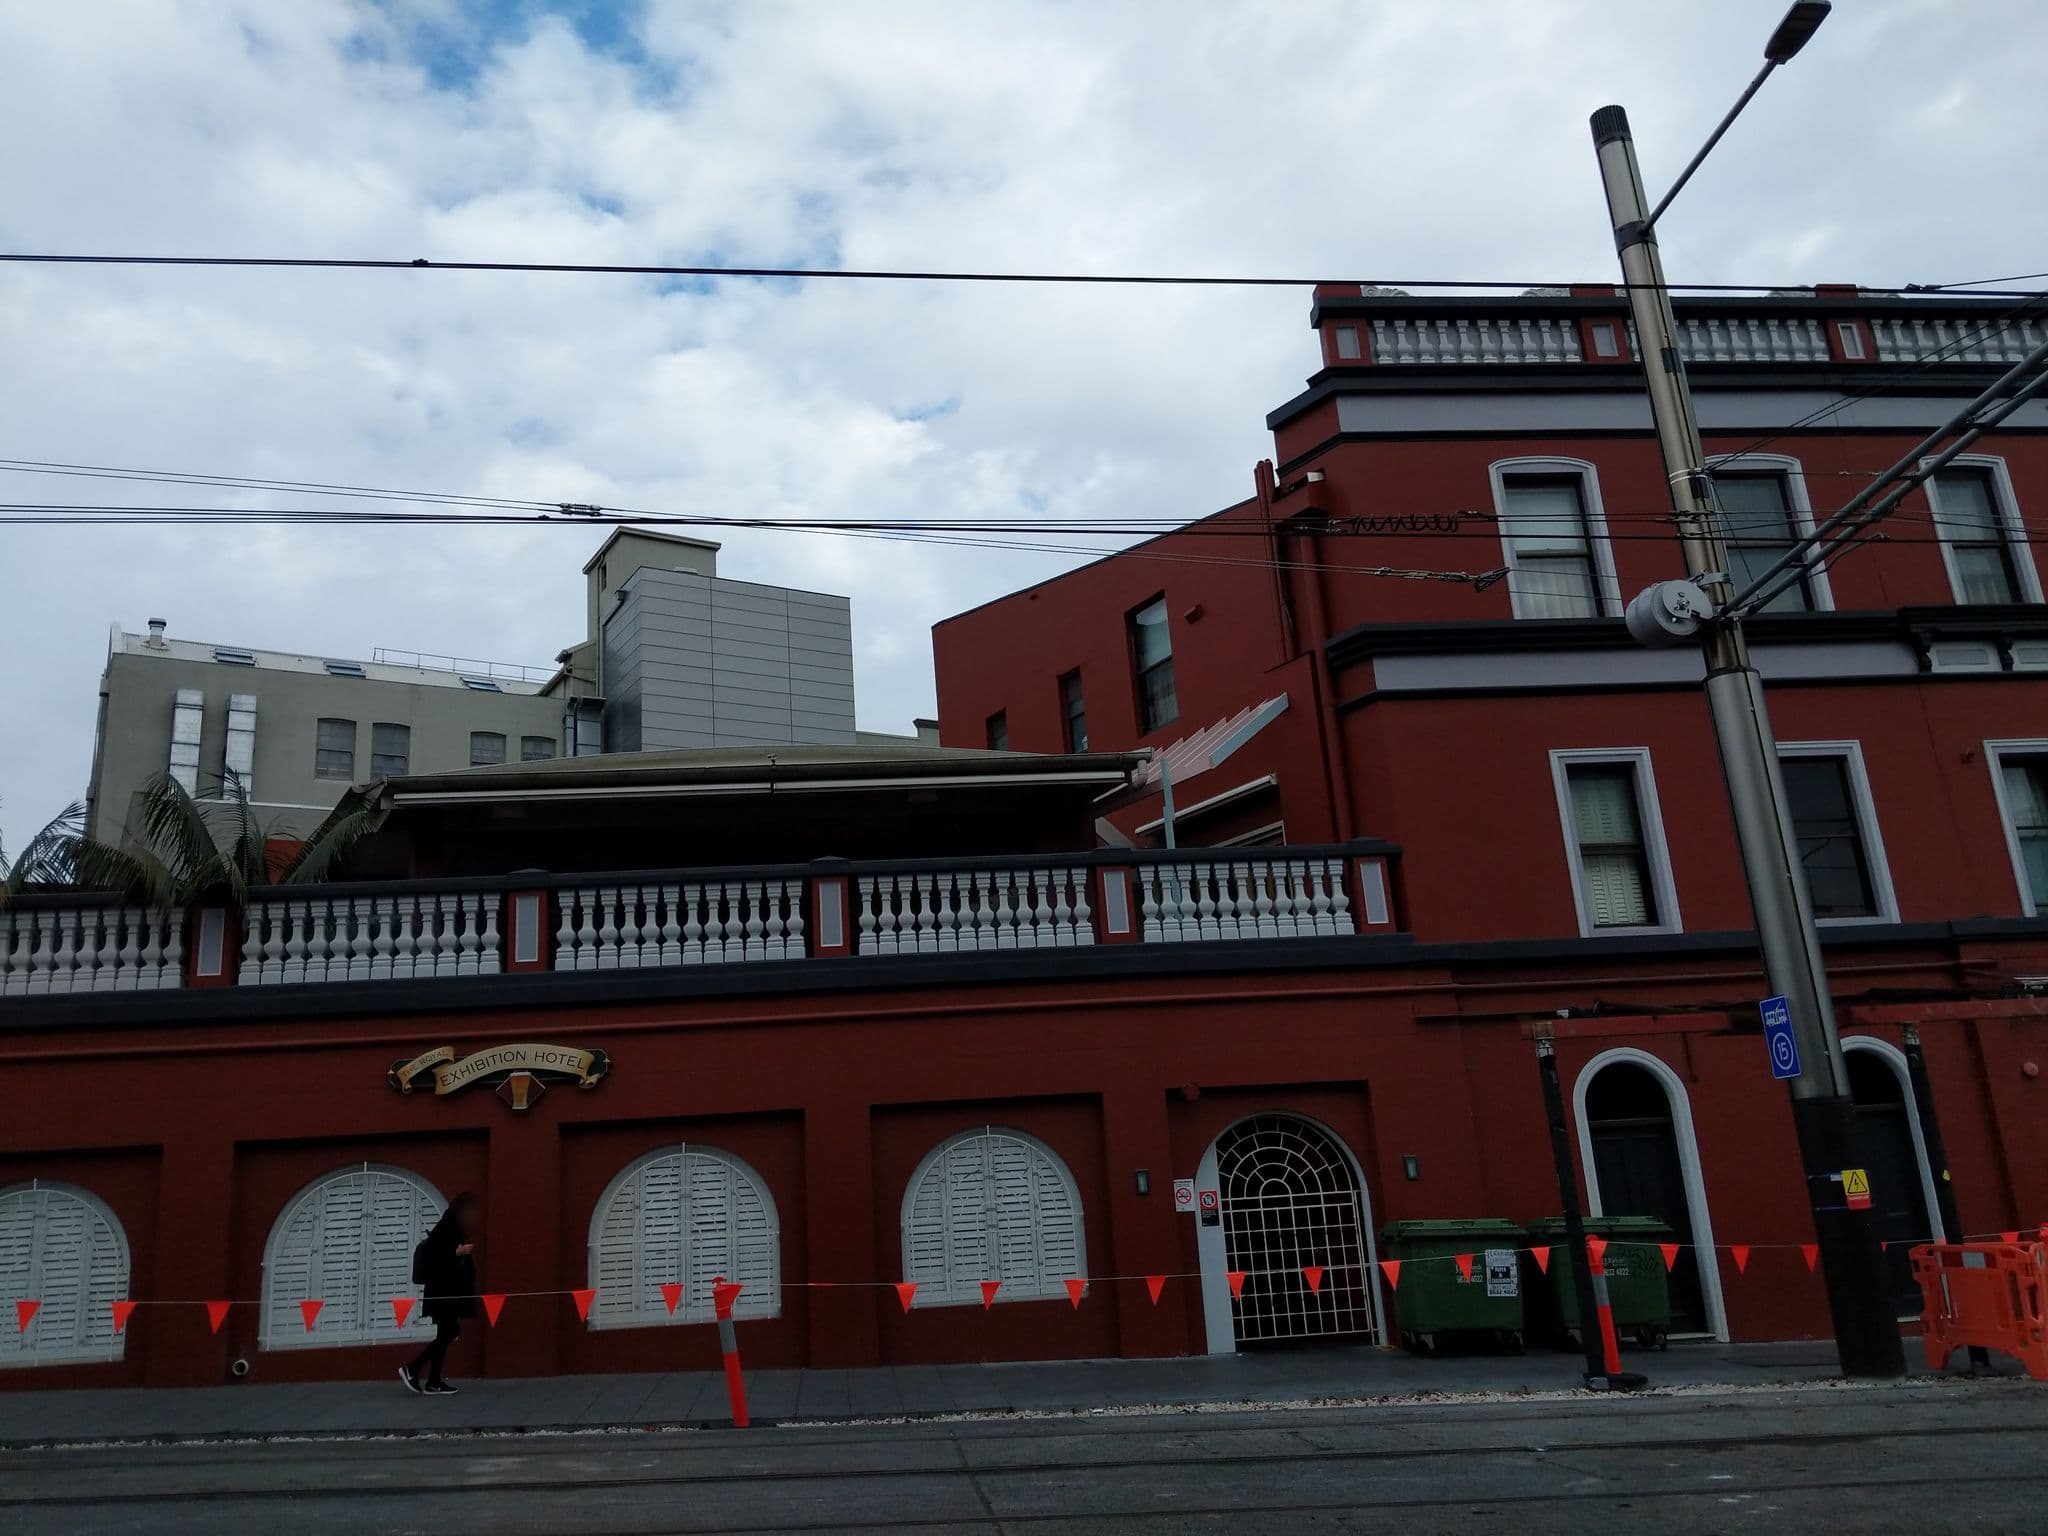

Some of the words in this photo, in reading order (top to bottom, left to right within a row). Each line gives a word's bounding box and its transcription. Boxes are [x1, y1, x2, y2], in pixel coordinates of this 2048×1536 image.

[401, 1063, 417, 1078] THE
[420, 1050, 448, 1066] ROYAL
[1777, 1041, 1789, 1061] 15
[440, 1050, 527, 1087] EXHIBITION
[534, 1050, 585, 1070] HOTEL
